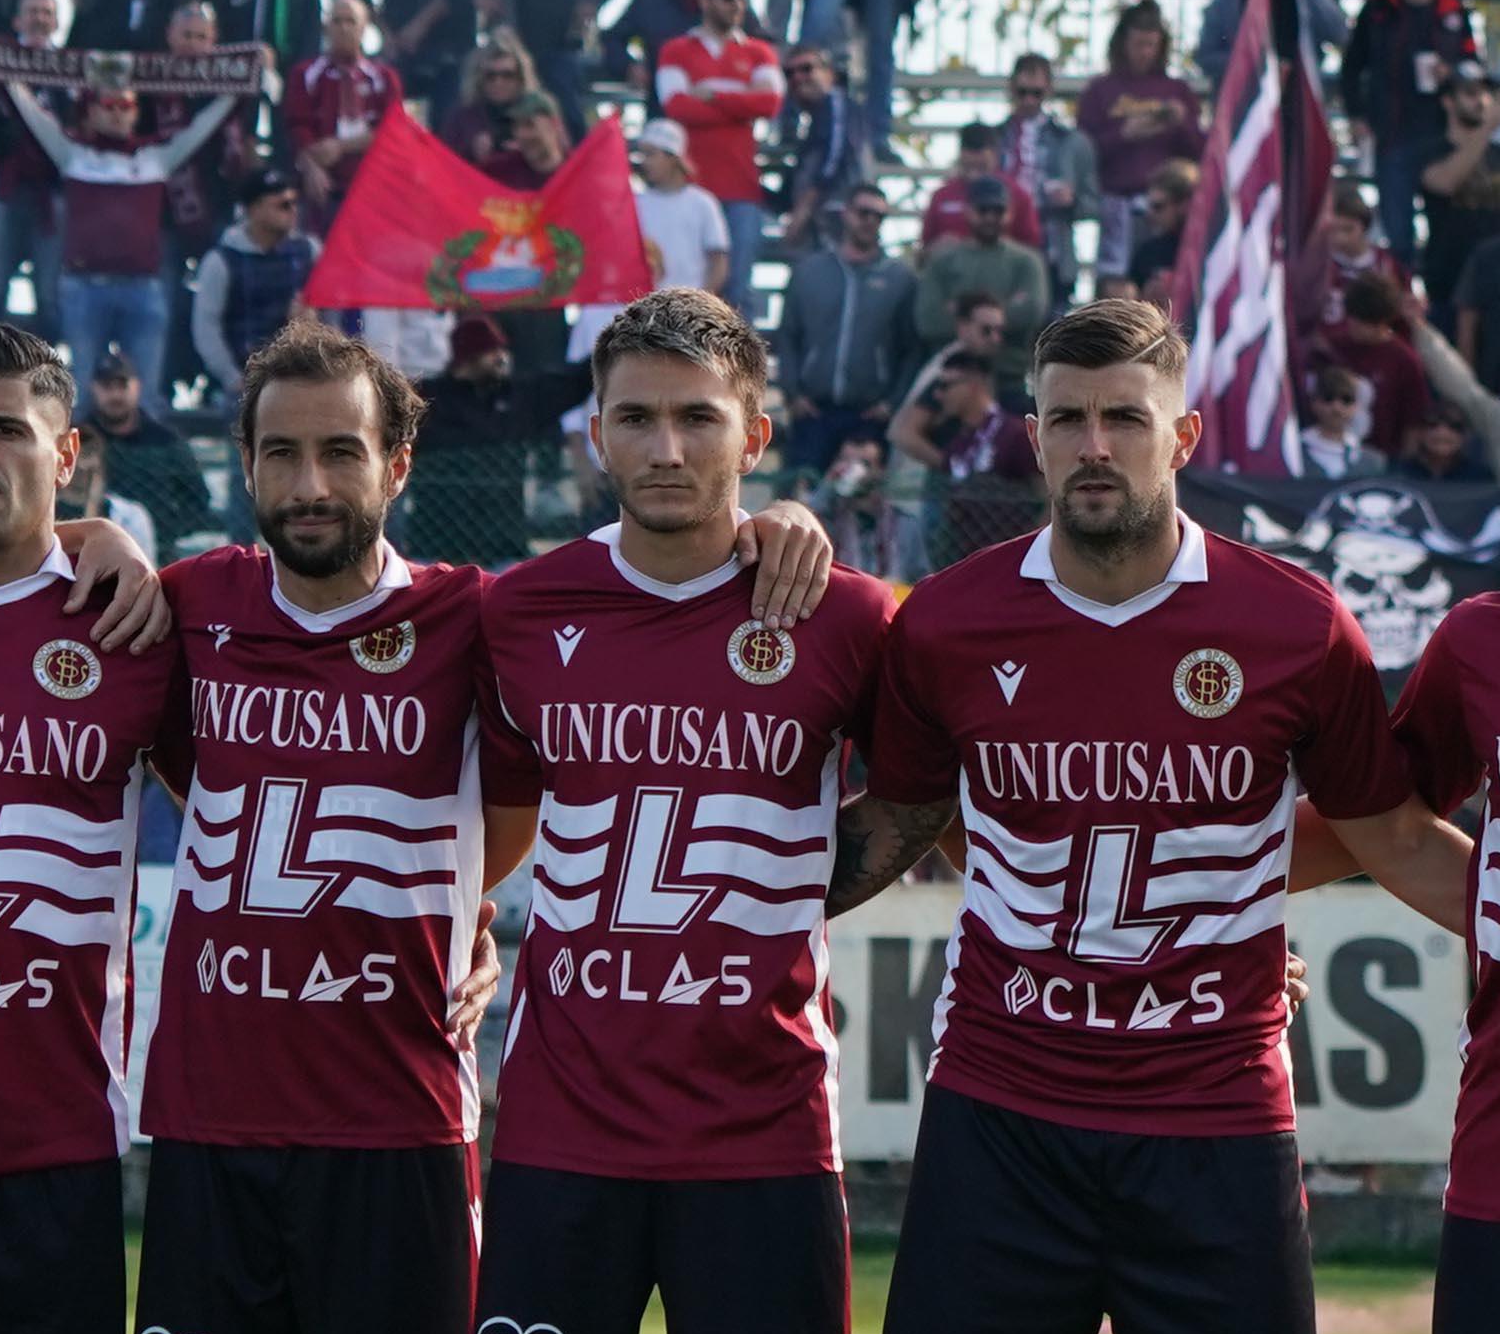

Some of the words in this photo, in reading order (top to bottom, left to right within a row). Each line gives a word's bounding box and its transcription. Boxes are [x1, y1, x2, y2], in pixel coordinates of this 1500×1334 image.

[191, 675, 427, 757] UNICUSANO
[539, 702, 804, 779] UNICUSANO
[977, 740, 1256, 804] UNICUSANO
[220, 945, 396, 1003] CLAS
[580, 951, 752, 1007] CLAS
[1042, 970, 1227, 1031] CLAS
